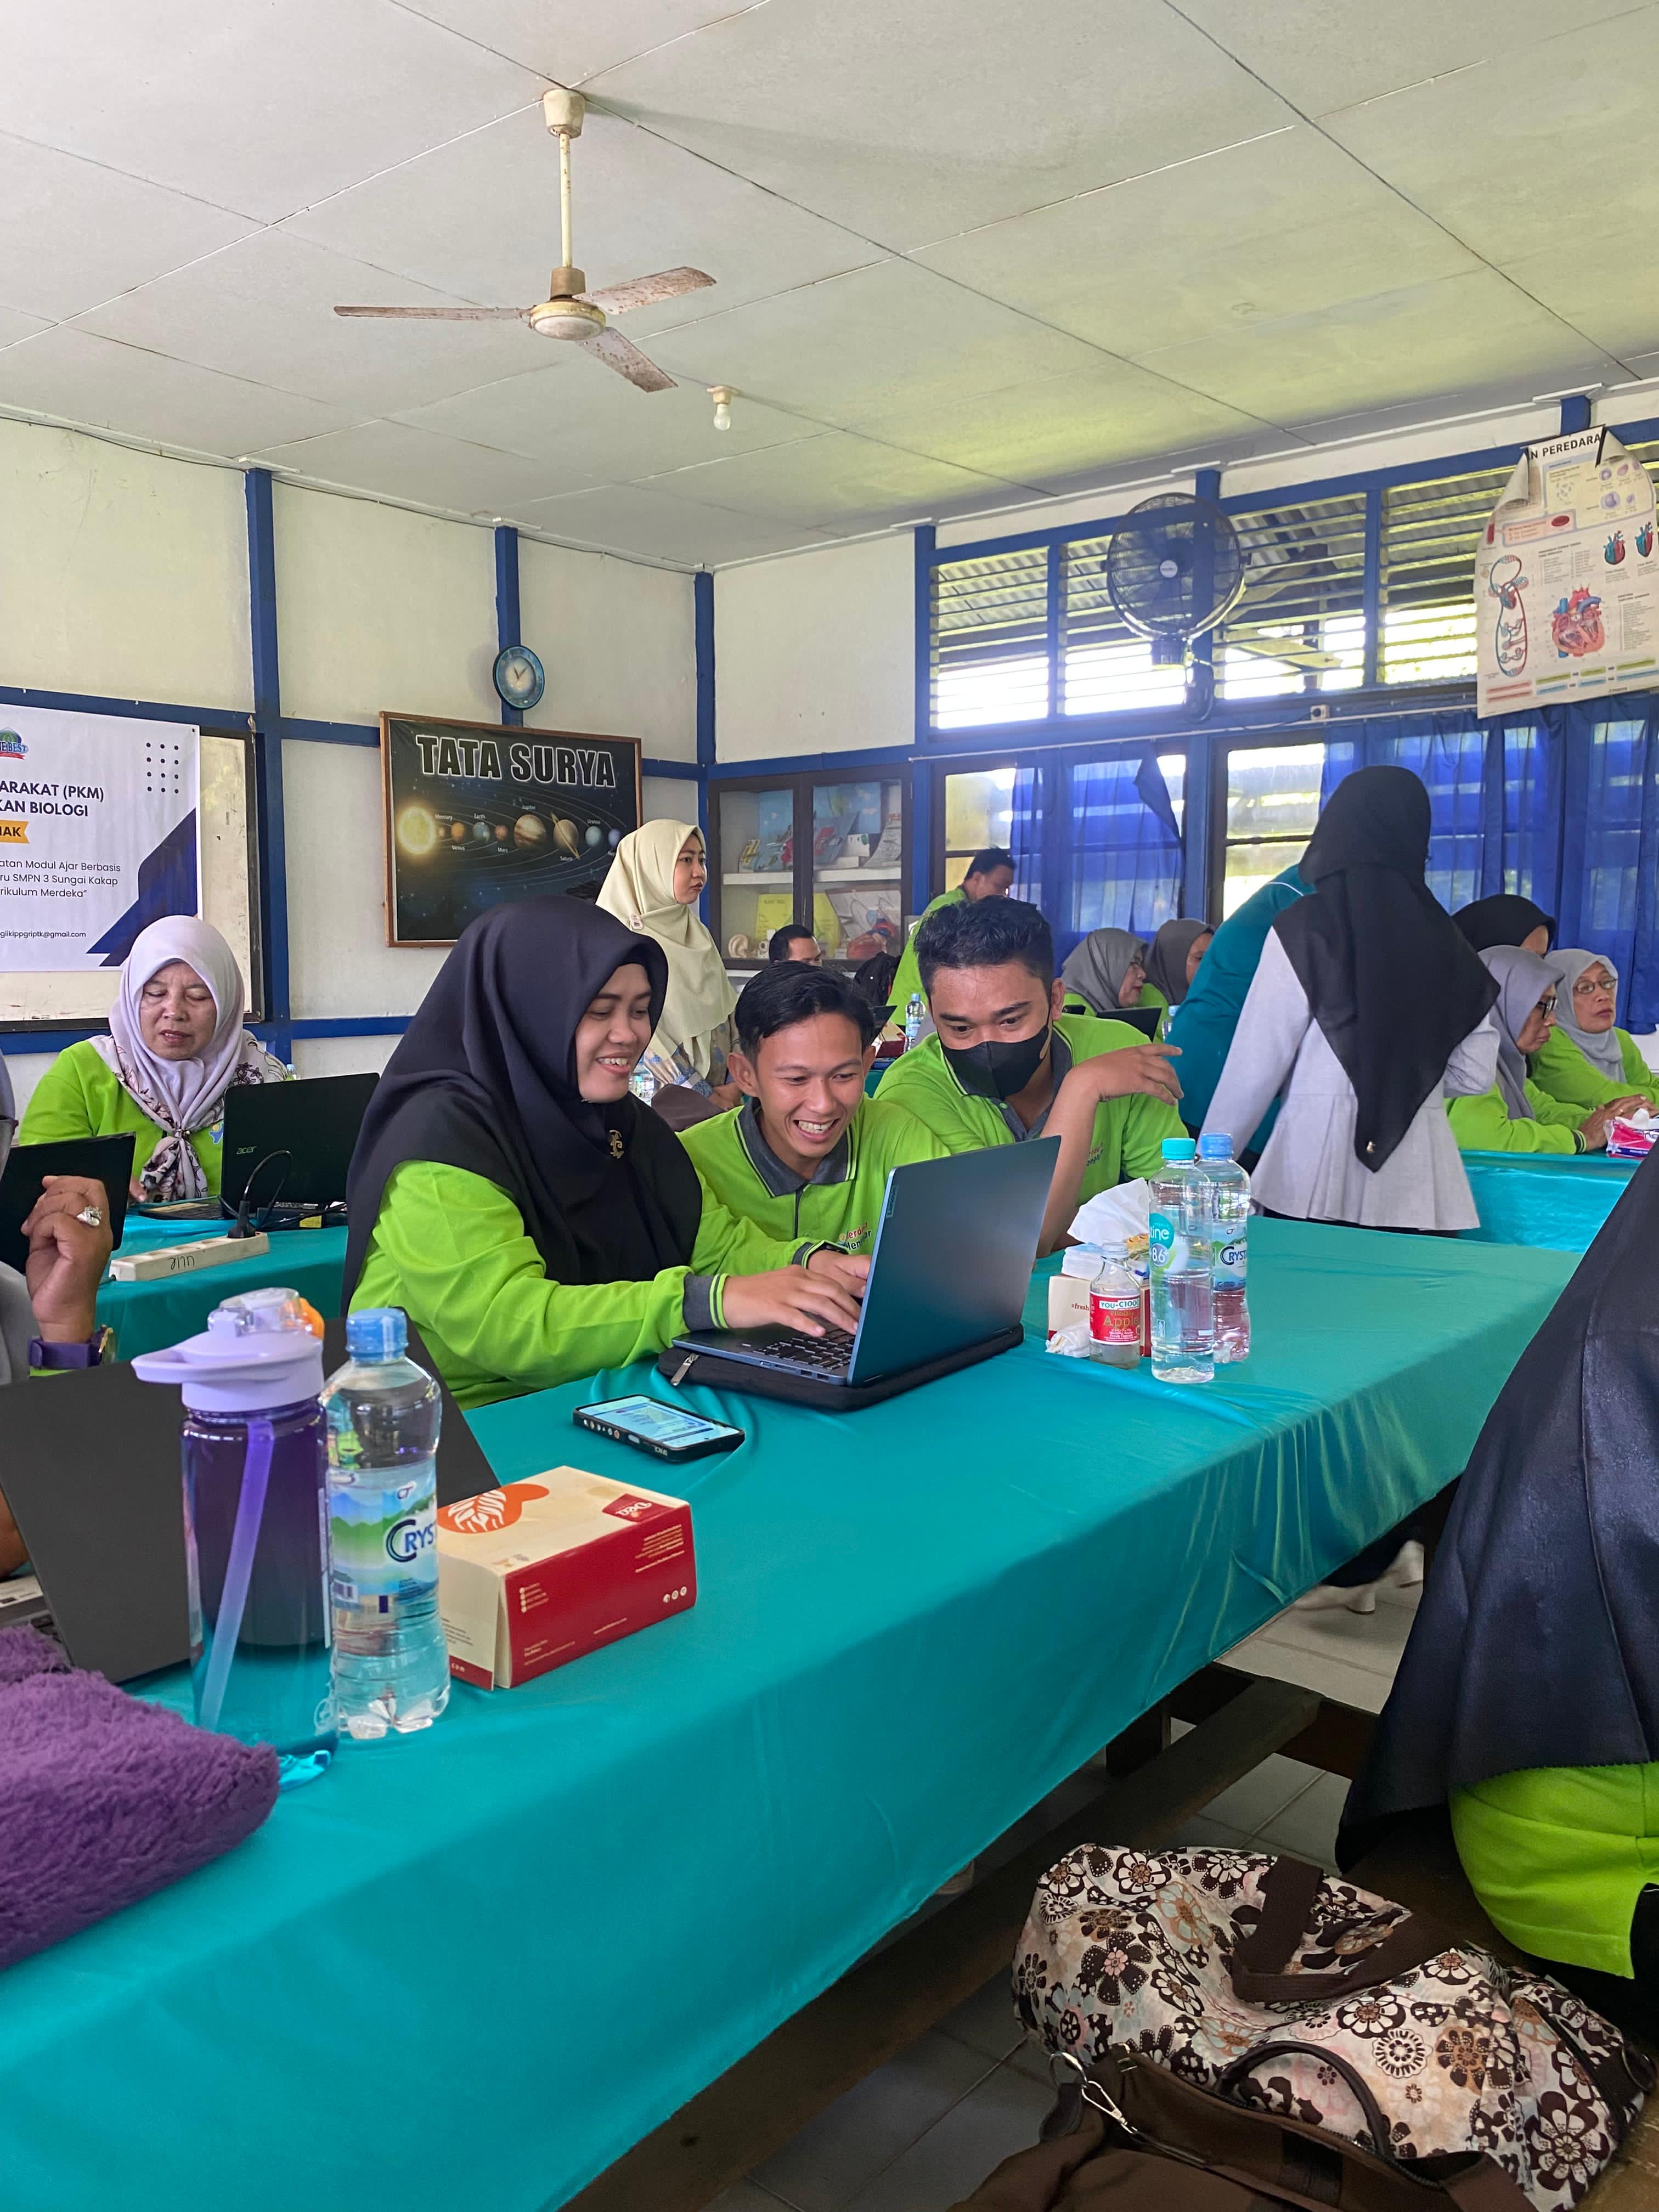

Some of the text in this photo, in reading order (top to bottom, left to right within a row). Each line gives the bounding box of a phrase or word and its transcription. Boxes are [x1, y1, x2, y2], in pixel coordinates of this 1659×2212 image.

[1542, 433, 1601, 456] PEREDARA
[415, 735, 616, 788] TATA SURYA
[63, 785, 104, 803] (PKM)
[30, 801, 88, 817] BIOLOGI
[26, 860, 56, 869] Modul
[59, 862, 78, 872] Ajar
[81, 863, 121, 872] Berbasis
[13, 873, 41, 882] SMPN
[52, 875, 86, 886] Sungai
[89, 877, 118, 887] Kakap
[1, 887, 38, 896] rikulum
[236, 1146, 257, 1155] acer
